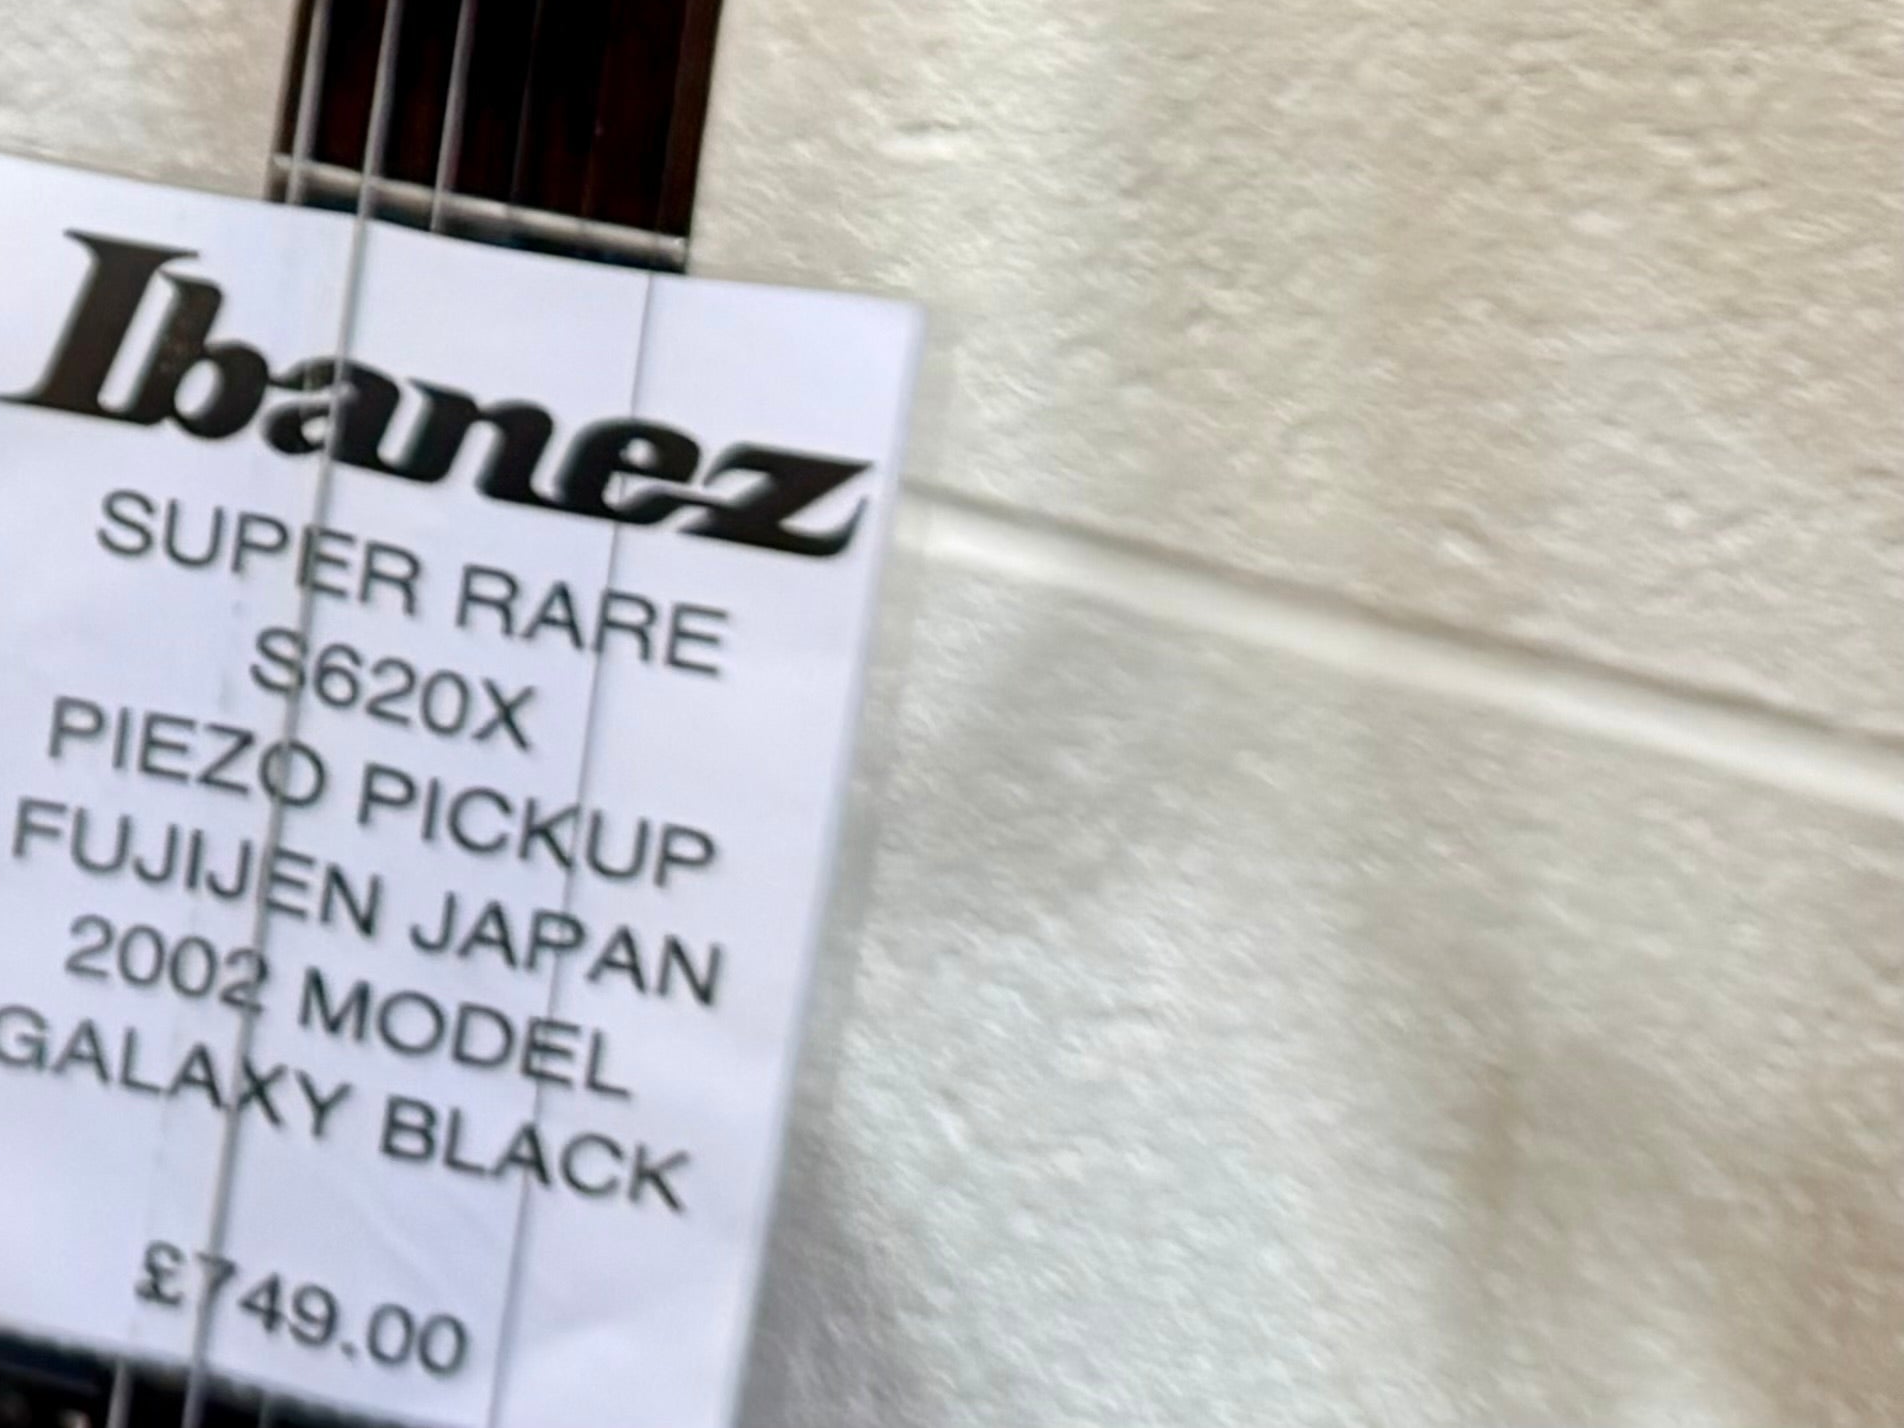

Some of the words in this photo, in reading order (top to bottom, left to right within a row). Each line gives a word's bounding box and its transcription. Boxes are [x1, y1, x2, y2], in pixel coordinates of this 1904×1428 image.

[96, 489, 422, 617] SUPER
[455, 563, 731, 678] RARE
[249, 625, 536, 752] S620X
[47, 695, 328, 808] PIEZO
[356, 761, 717, 888] PICKUP
[12, 796, 383, 938] FUJIJEN
[409, 890, 723, 1008] JAPAN
[64, 913, 271, 1014] 2002
[298, 965, 633, 1102] MODEL
[379, 1094, 691, 1214] BLACK
[134, 1240, 468, 1376] £749.00
